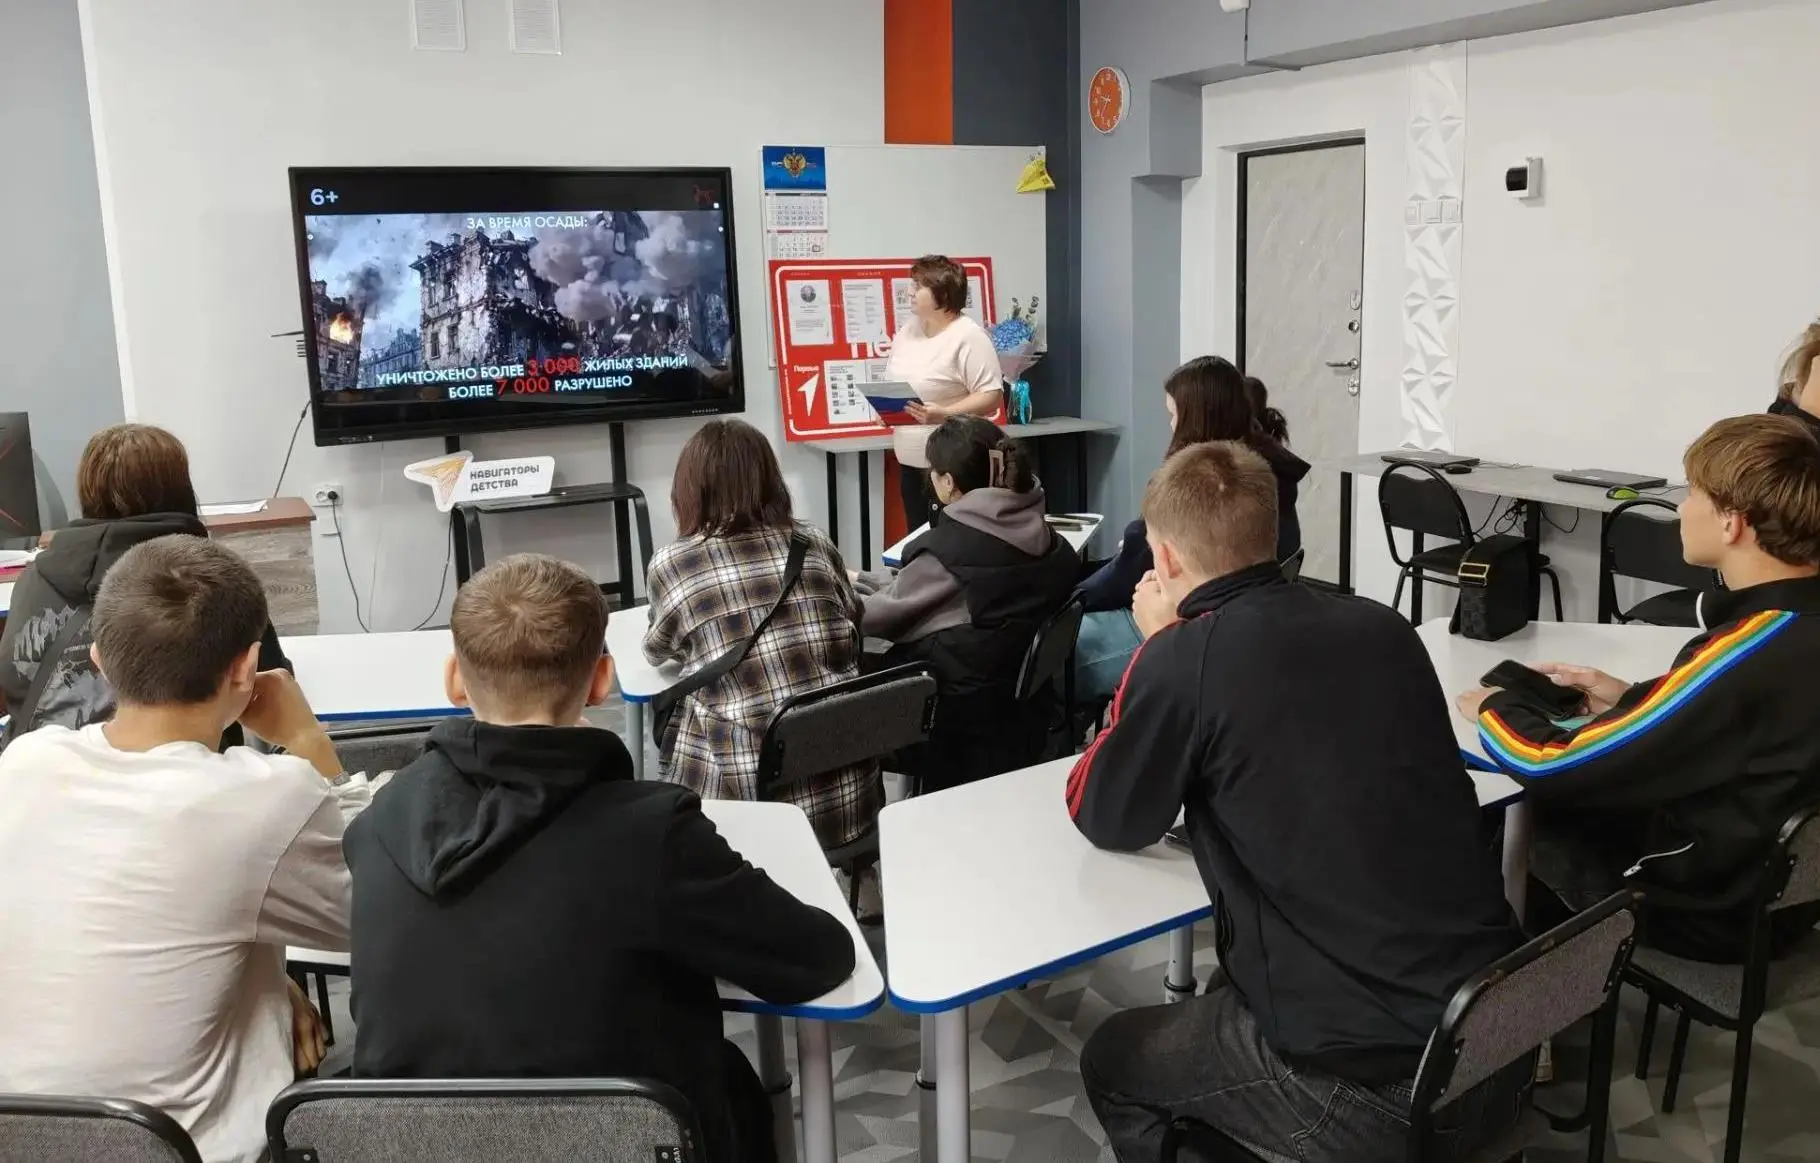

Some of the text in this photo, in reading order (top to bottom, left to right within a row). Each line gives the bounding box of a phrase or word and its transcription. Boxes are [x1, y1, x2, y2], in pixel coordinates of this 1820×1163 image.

[310, 188, 338, 205] 6+
[467, 215, 588, 229] ЗА ВРЕМЯ ОСАДЫ:
[376, 367, 477, 385] УНИЧТОЖЕНО
[480, 364, 524, 379] БОЛЕЕ
[528, 360, 537, 376] 3
[584, 357, 633, 372] ЖИЛЫХ
[635, 353, 688, 369] ЗДАНИЙ
[448, 375, 633, 398] БОЛЕЕ 7 000 РАЗРУШЕНО
[470, 465, 539, 480] НАВИГАТОРЫ
[471, 479, 518, 493] ДЕТСТВА
